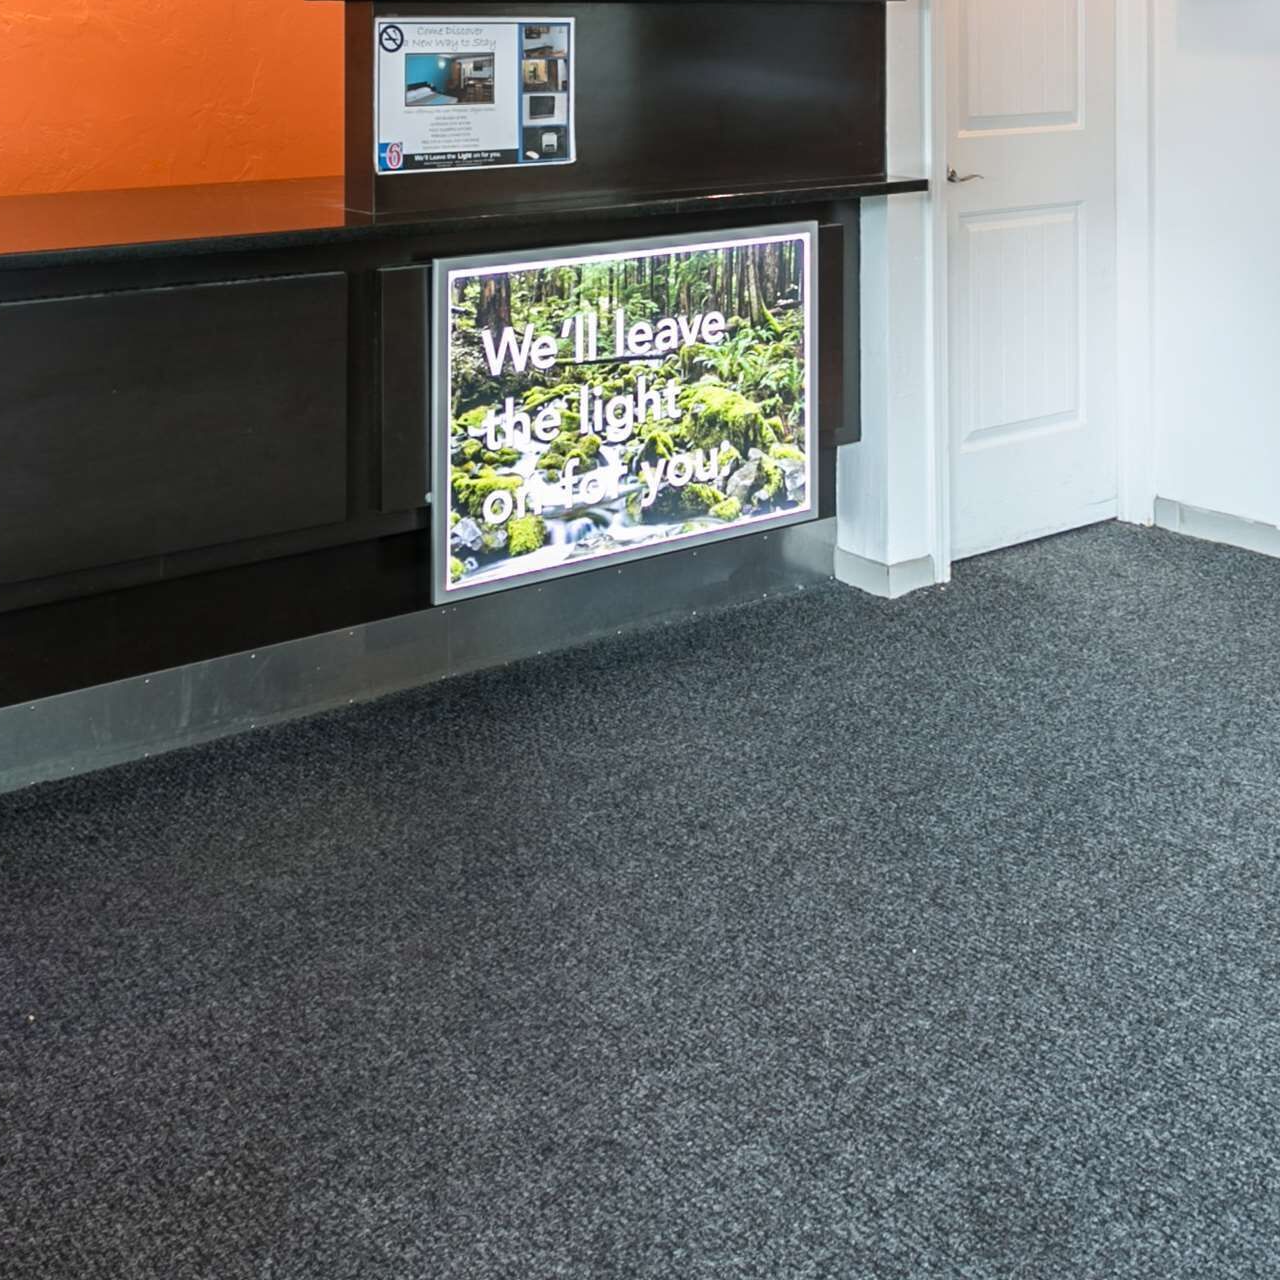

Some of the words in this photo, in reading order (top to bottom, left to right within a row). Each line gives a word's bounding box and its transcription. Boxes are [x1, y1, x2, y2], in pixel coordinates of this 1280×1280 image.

[412, 39, 433, 48] New
[438, 39, 458, 51] Way
[471, 39, 496, 51] Stay
[386, 143, 403, 169] 6
[482, 311, 597, 376] We'll
[615, 308, 725, 356] leave
[483, 397, 561, 450] the
[580, 374, 682, 442] light
[483, 487, 543, 524] on
[562, 457, 628, 509] for
